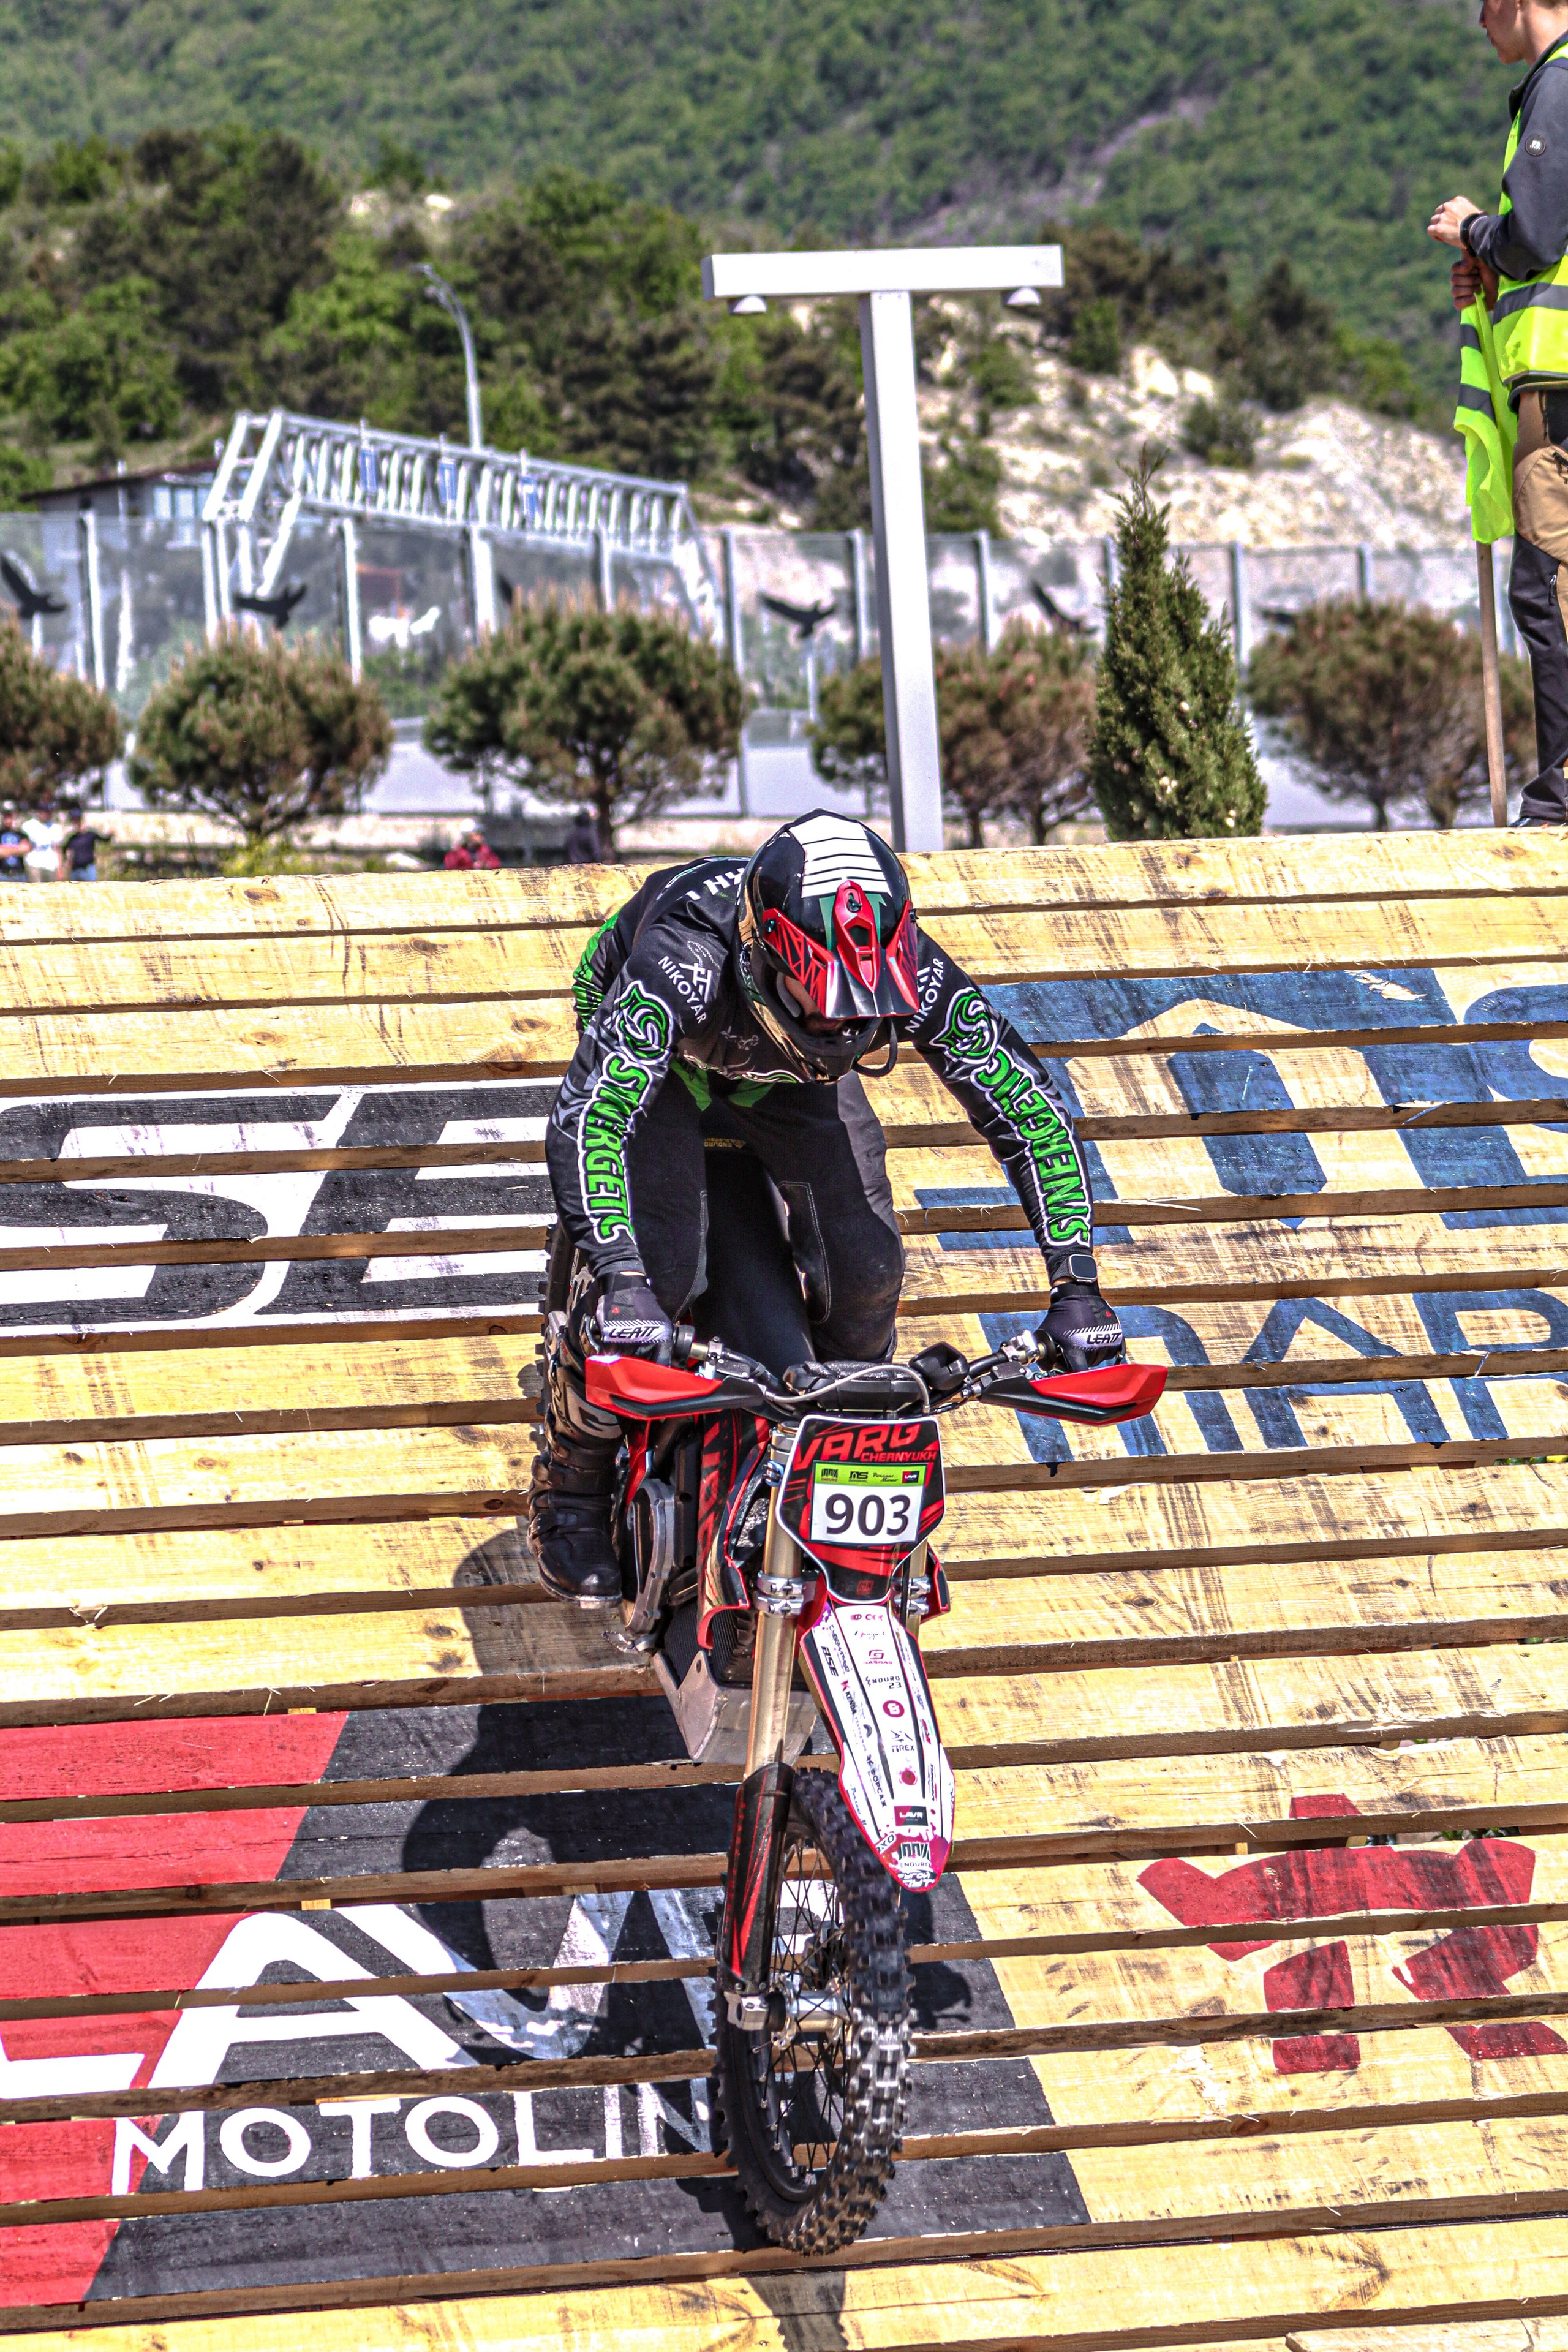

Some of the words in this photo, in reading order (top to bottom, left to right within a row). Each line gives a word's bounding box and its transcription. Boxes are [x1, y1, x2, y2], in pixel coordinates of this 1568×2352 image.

[658, 956, 707, 1024] NIKOYAR
[904, 958, 944, 1033] NIKOYAR
[609, 1325, 660, 1338] LEATT
[1087, 1332, 1122, 1344] LEATT
[793, 1423, 921, 1471] VARG
[860, 1450, 938, 1462] CHERNYUKH
[825, 1493, 911, 1536] 903
[845, 1691, 858, 1715] KENDA
[111, 2076, 790, 2196] MOTOLIN
